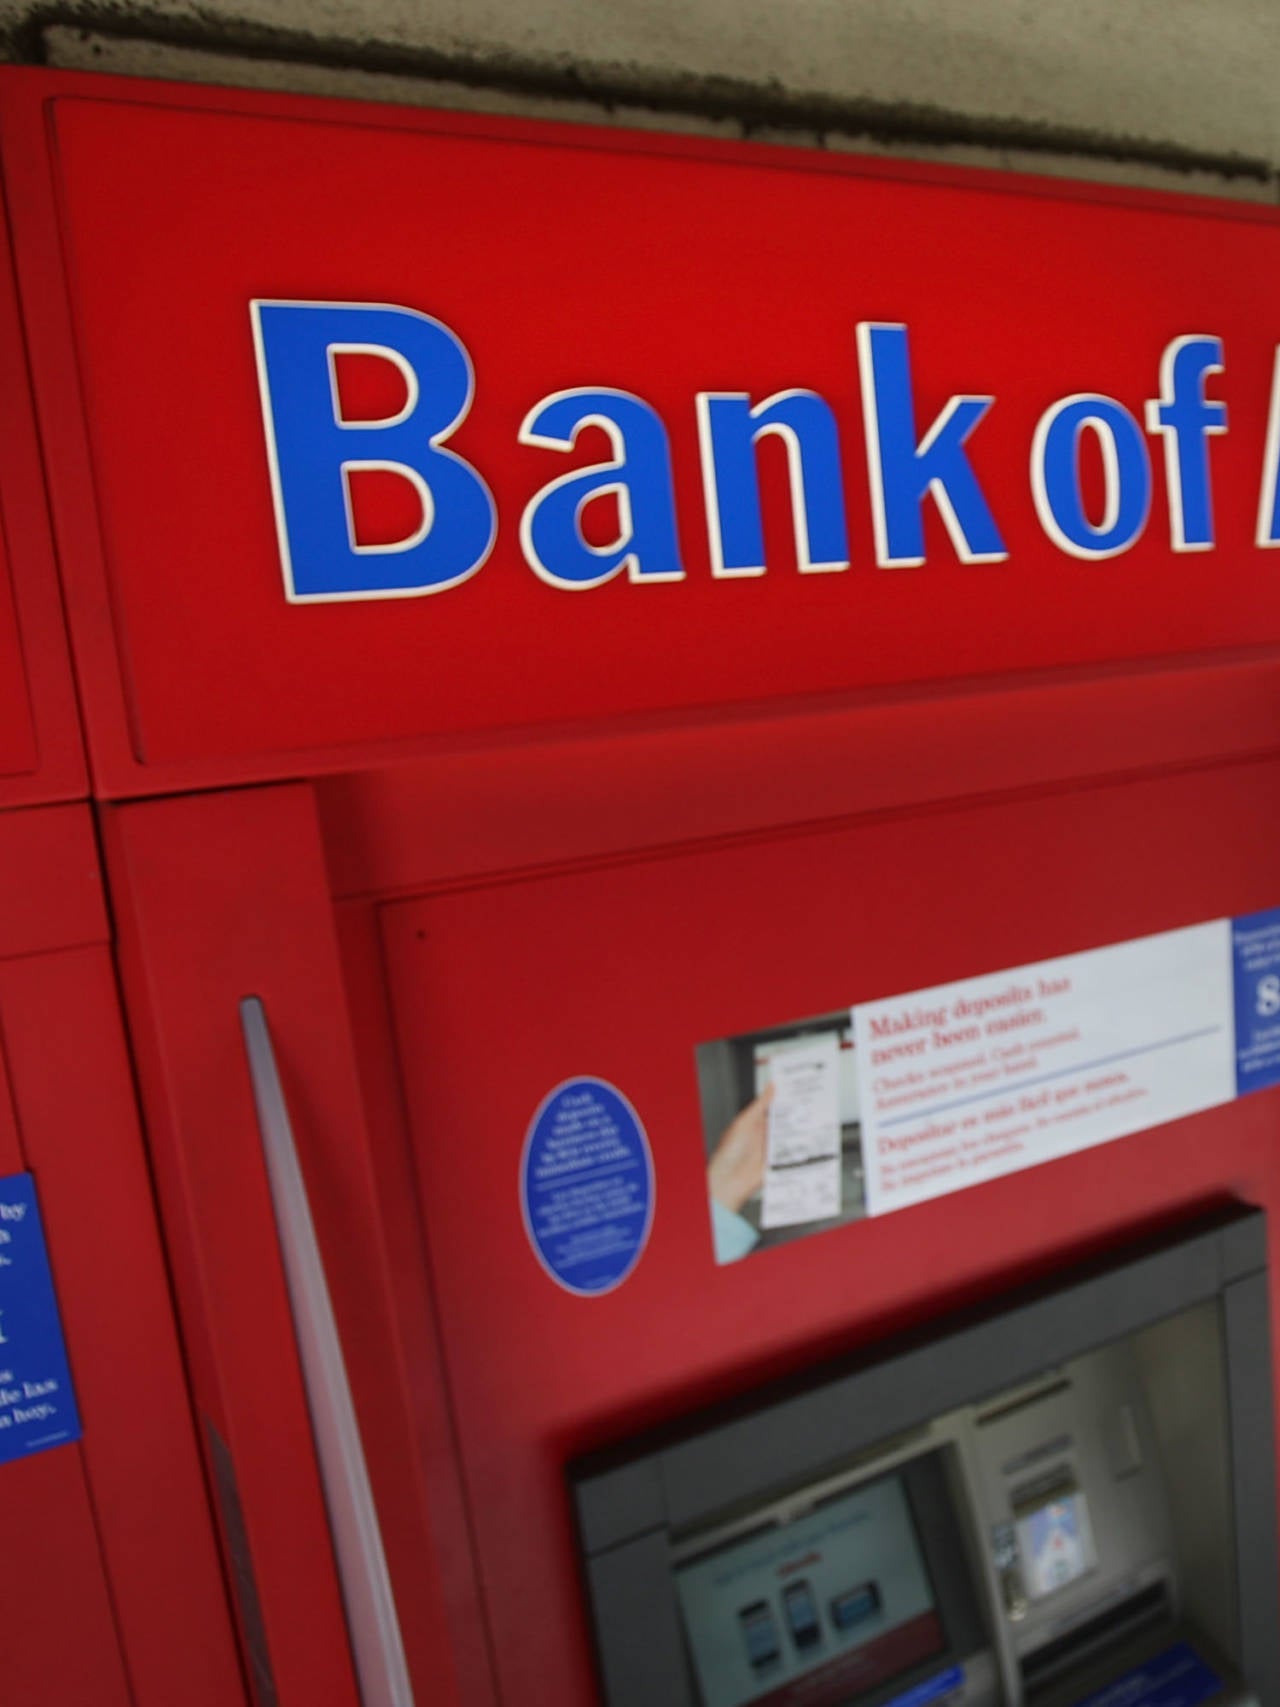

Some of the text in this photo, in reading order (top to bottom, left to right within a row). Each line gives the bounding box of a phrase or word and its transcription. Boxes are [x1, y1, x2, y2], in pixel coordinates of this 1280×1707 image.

[248, 297, 1009, 605] Bank
[1029, 333, 1229, 561] of
[868, 1007, 948, 1039] Making
[952, 986, 1033, 1019] deposits
[870, 1036, 928, 1066] never
[931, 1023, 982, 1050] been
